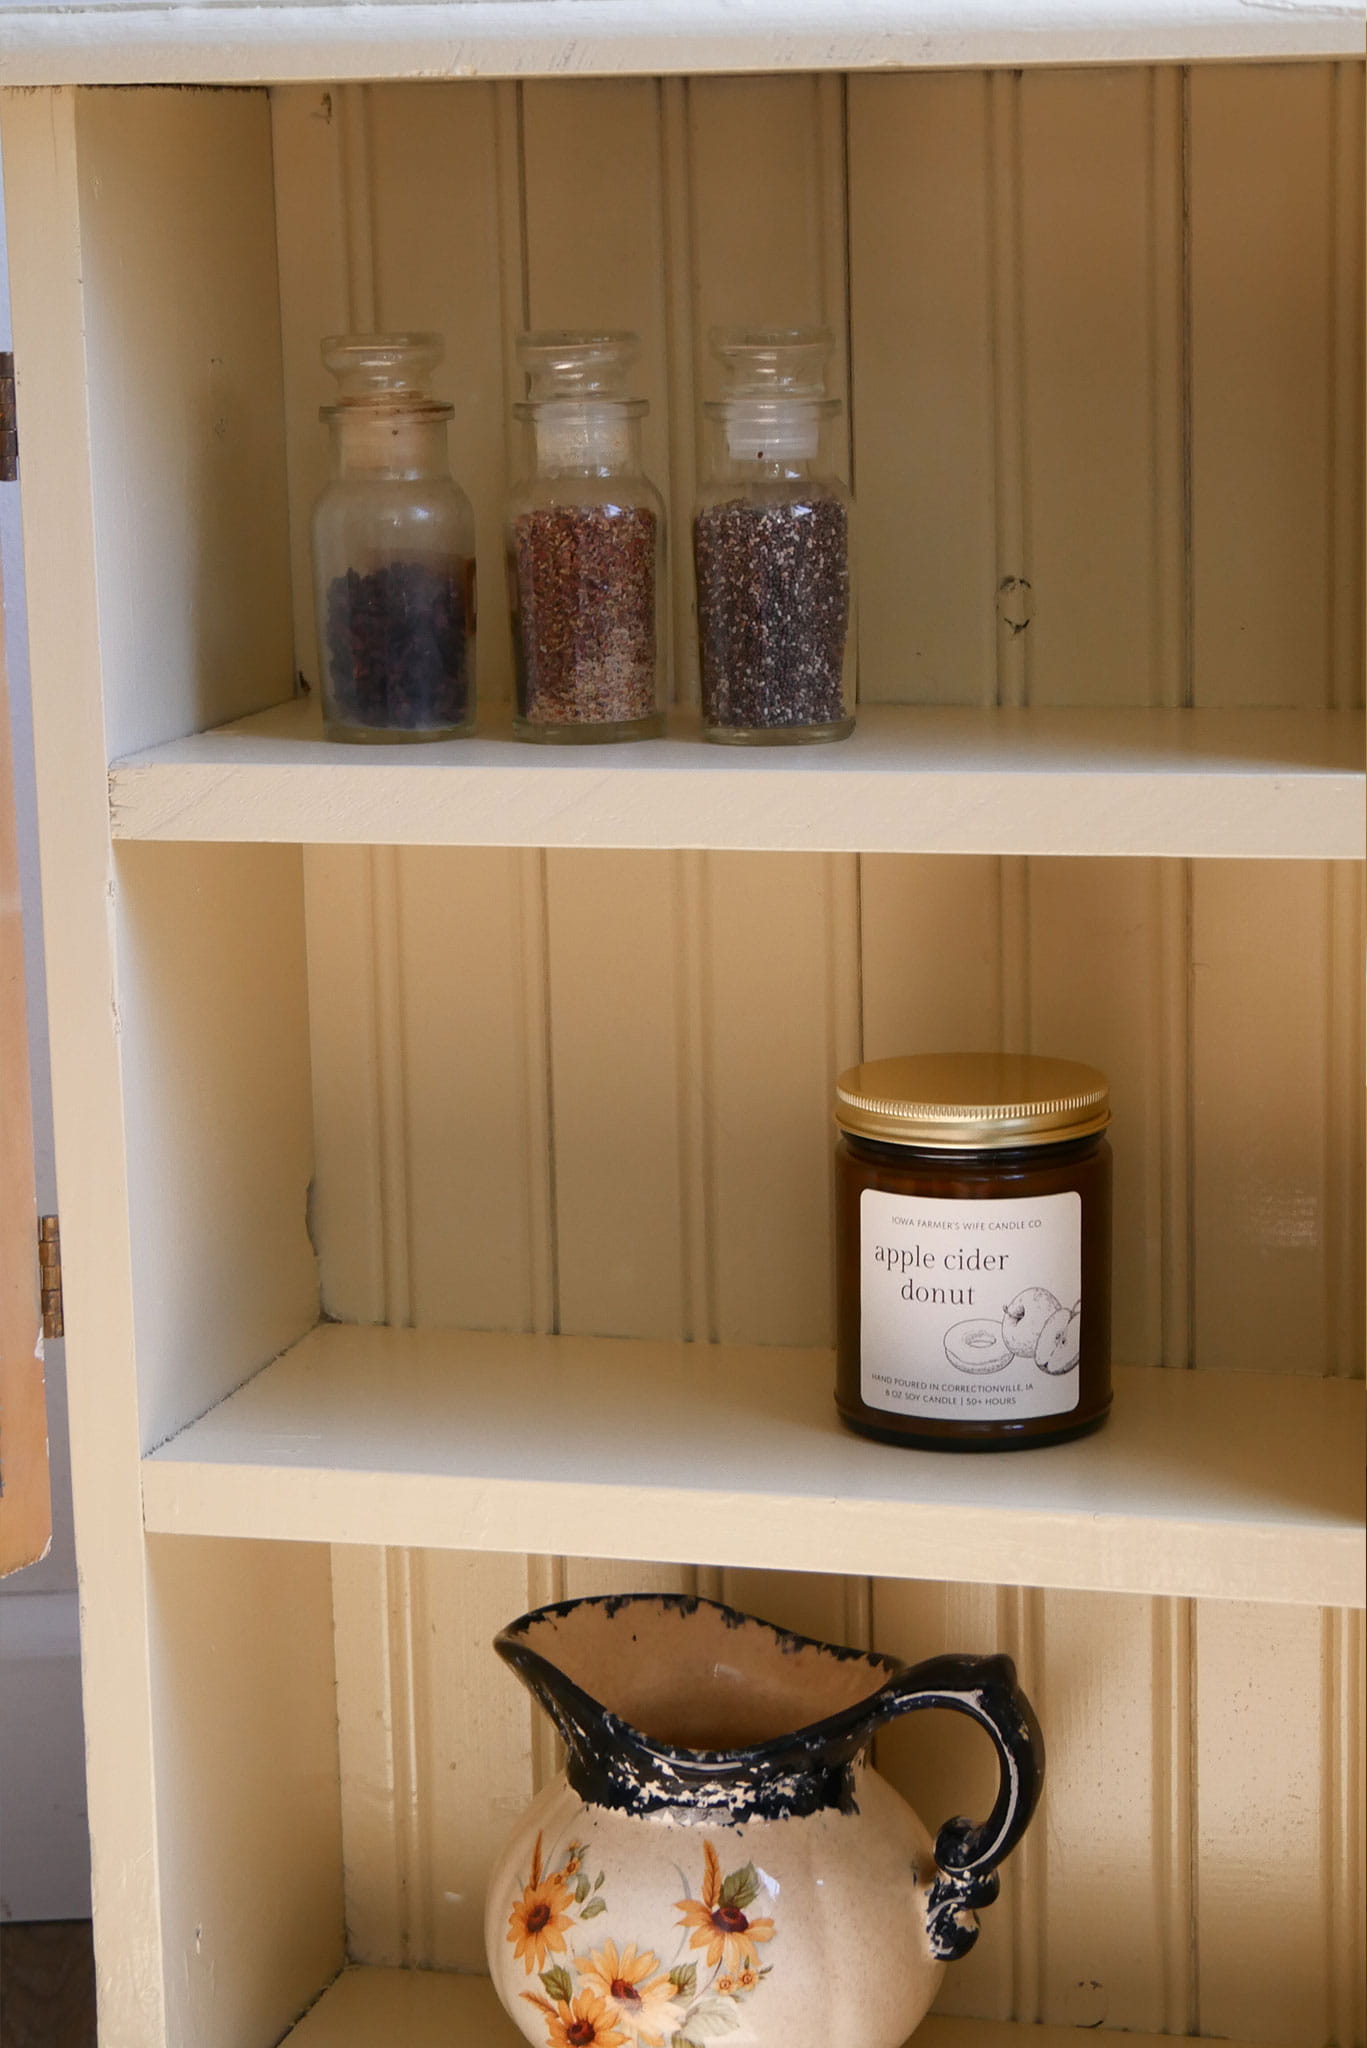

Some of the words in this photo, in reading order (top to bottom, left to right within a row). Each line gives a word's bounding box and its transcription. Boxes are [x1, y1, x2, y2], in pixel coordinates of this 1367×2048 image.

[892, 1216, 914, 1227] IOWA
[917, 1219, 960, 1231] FARMER'S
[963, 1222, 985, 1231] WIFE
[988, 1220, 1025, 1231] CANDLE
[1028, 1219, 1042, 1229] CO
[874, 1244, 936, 1273] apple
[943, 1248, 1010, 1271] cider
[900, 1278, 975, 1306] donut
[871, 1373, 893, 1385] HAND
[894, 1378, 928, 1390] POURED
[929, 1383, 939, 1391] IN
[941, 1383, 1024, 1393] CORRECTIONVILLE,
[1025, 1383, 1034, 1391] IA
[891, 1390, 903, 1399] OZ
[904, 1392, 921, 1401] SOY
[922, 1395, 957, 1405] CANDLE
[966, 1397, 982, 1406] 50+
[985, 1396, 1017, 1406] HOURS
